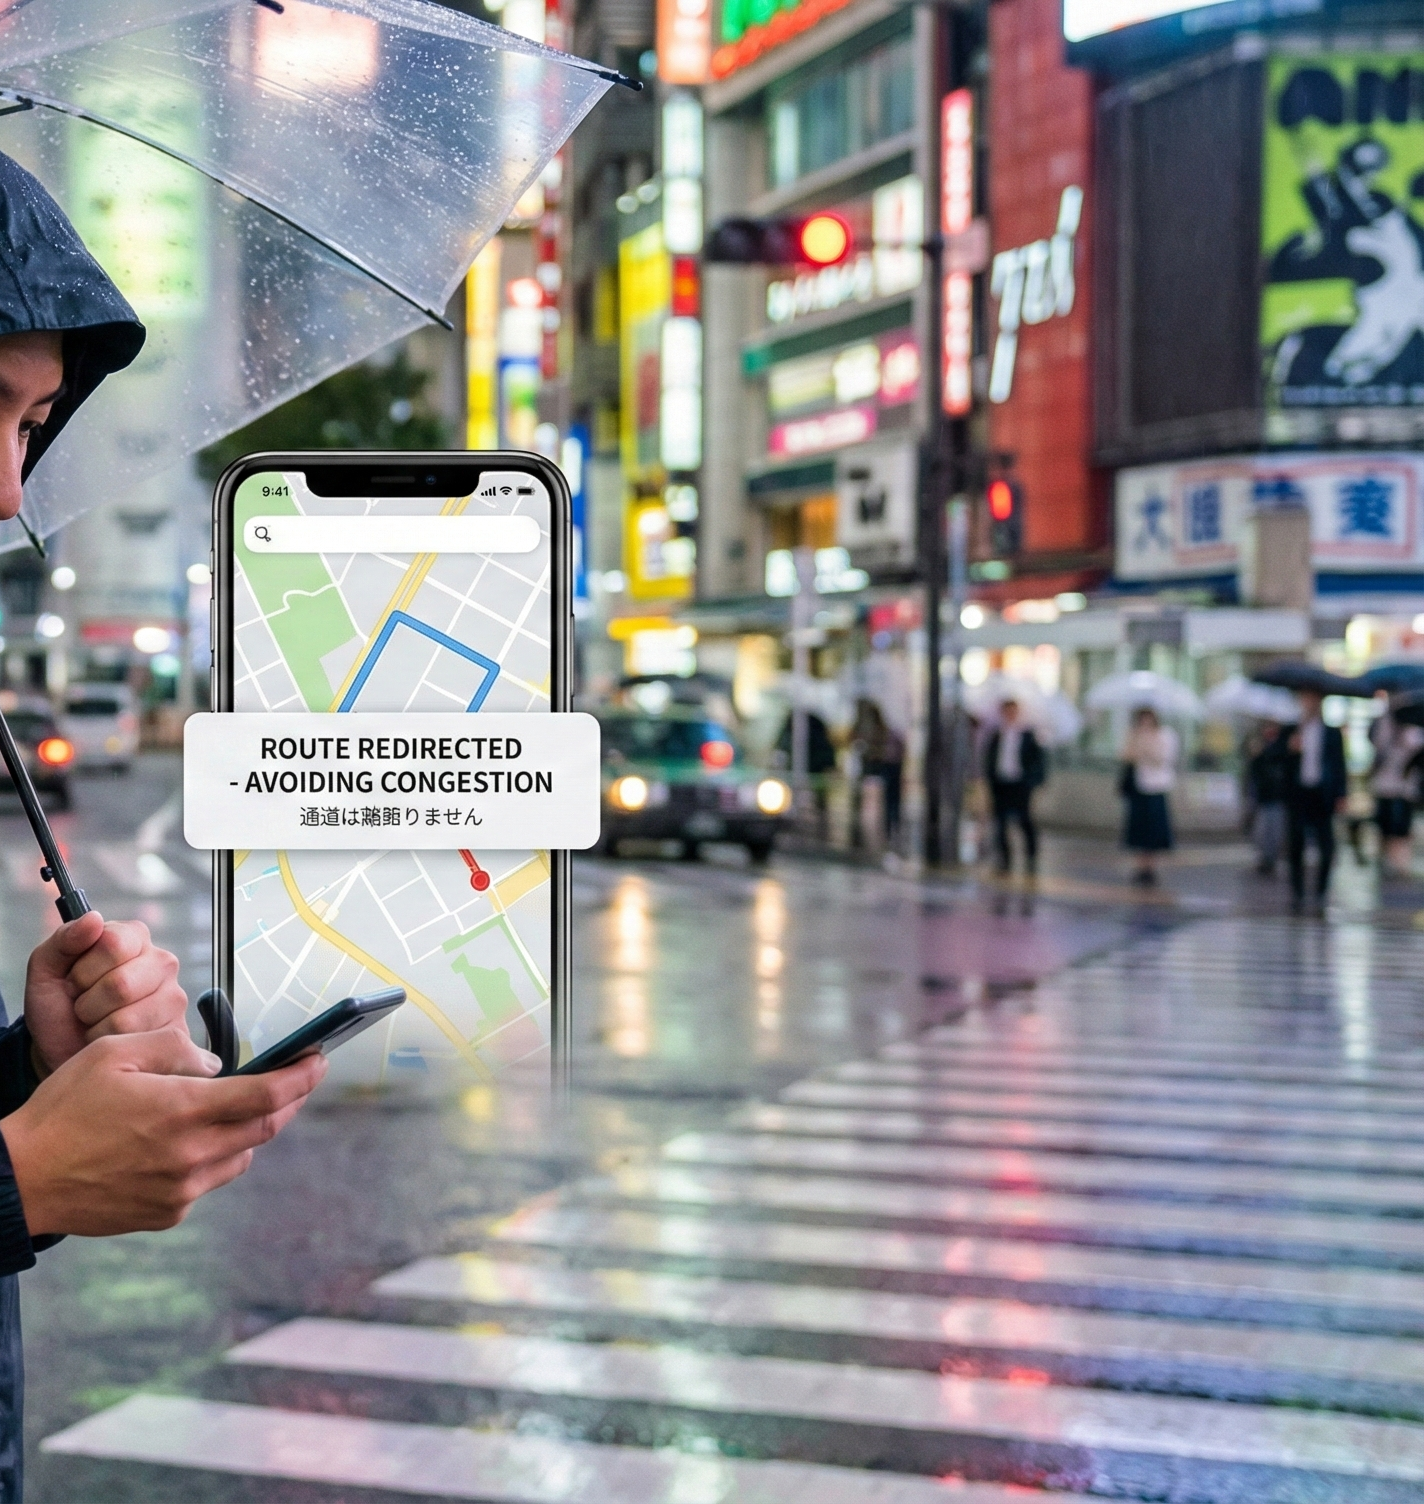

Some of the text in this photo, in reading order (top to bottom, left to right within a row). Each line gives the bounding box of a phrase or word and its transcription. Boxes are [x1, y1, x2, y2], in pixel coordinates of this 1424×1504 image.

[261, 485, 290, 498] 9:41
[261, 737, 522, 760] ROUTE REDIRECTED
[244, 770, 373, 794] AVOIDING
[380, 770, 553, 794] CONGESTION
